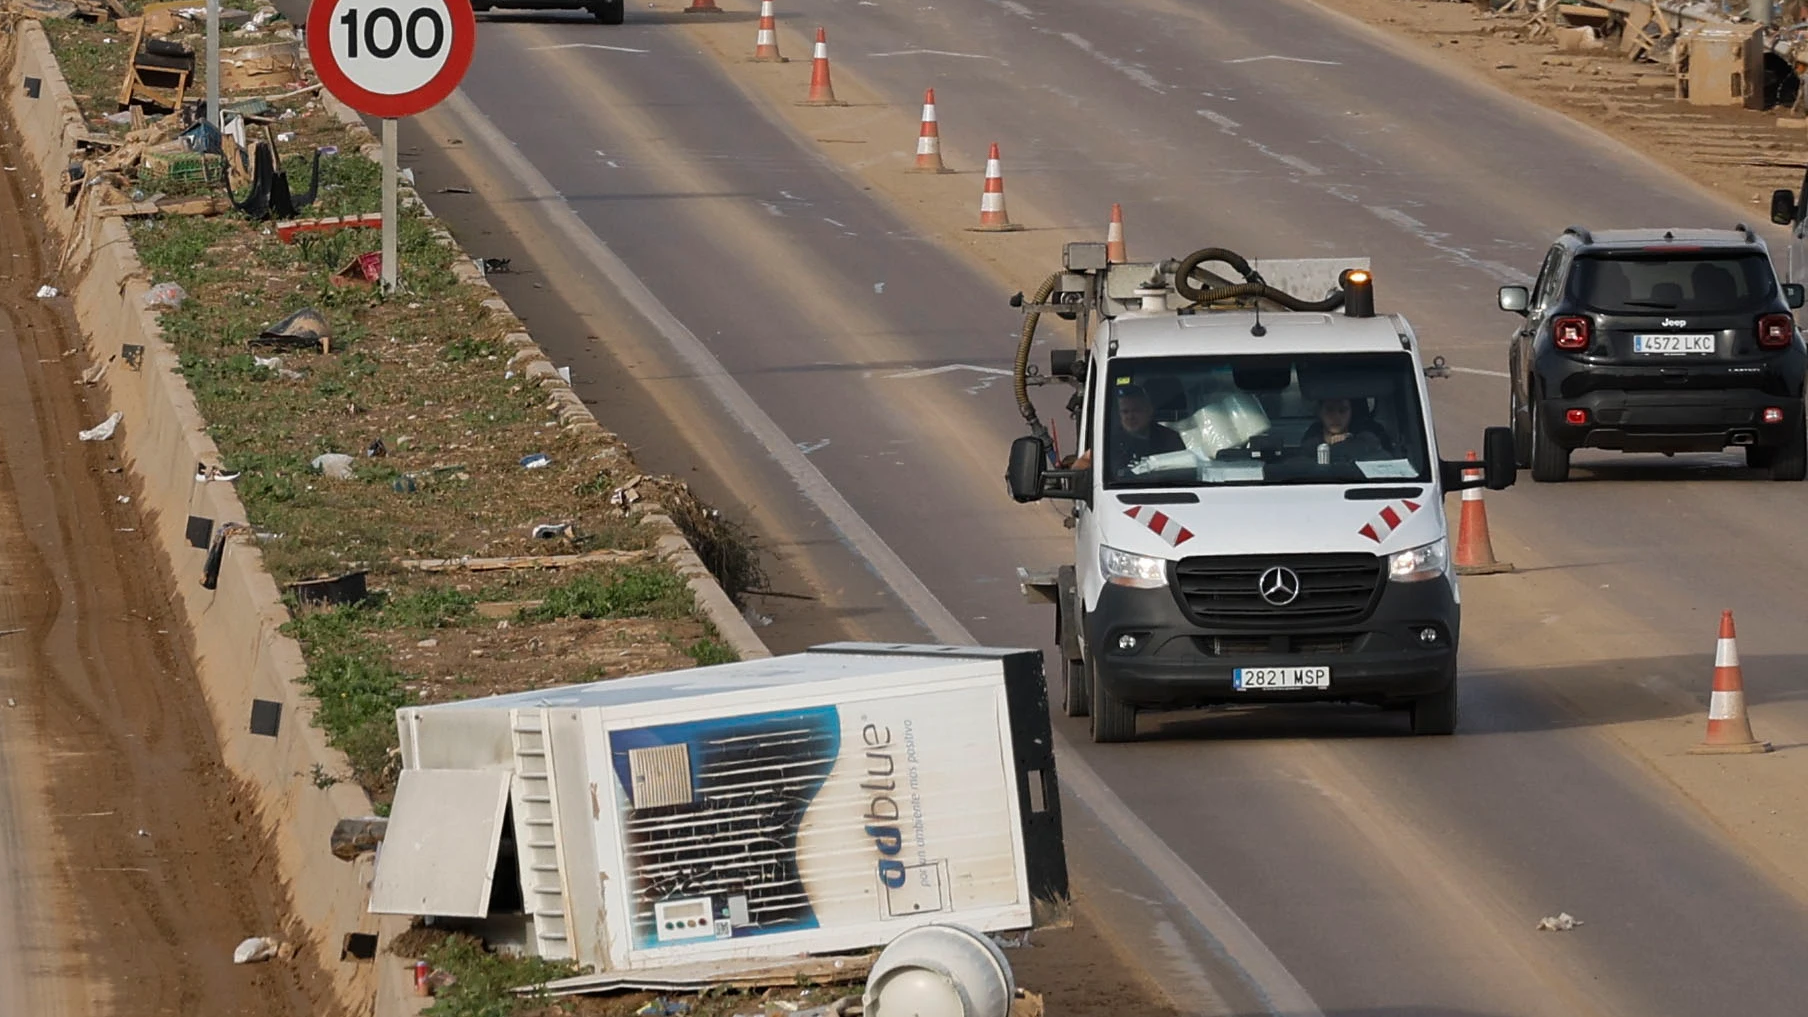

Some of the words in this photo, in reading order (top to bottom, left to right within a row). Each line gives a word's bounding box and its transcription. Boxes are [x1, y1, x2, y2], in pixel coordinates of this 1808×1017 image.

[340, 7, 445, 59] 100
[1661, 318, 1687, 328] Jeep
[1644, 336, 1680, 351] 4572
[1684, 336, 1711, 351] LKC
[1244, 670, 1286, 686] 2821
[1293, 669, 1325, 685] MSP
[903, 719, 920, 763] positivo
[909, 792, 926, 849] ambiente
[917, 865, 932, 887] por
